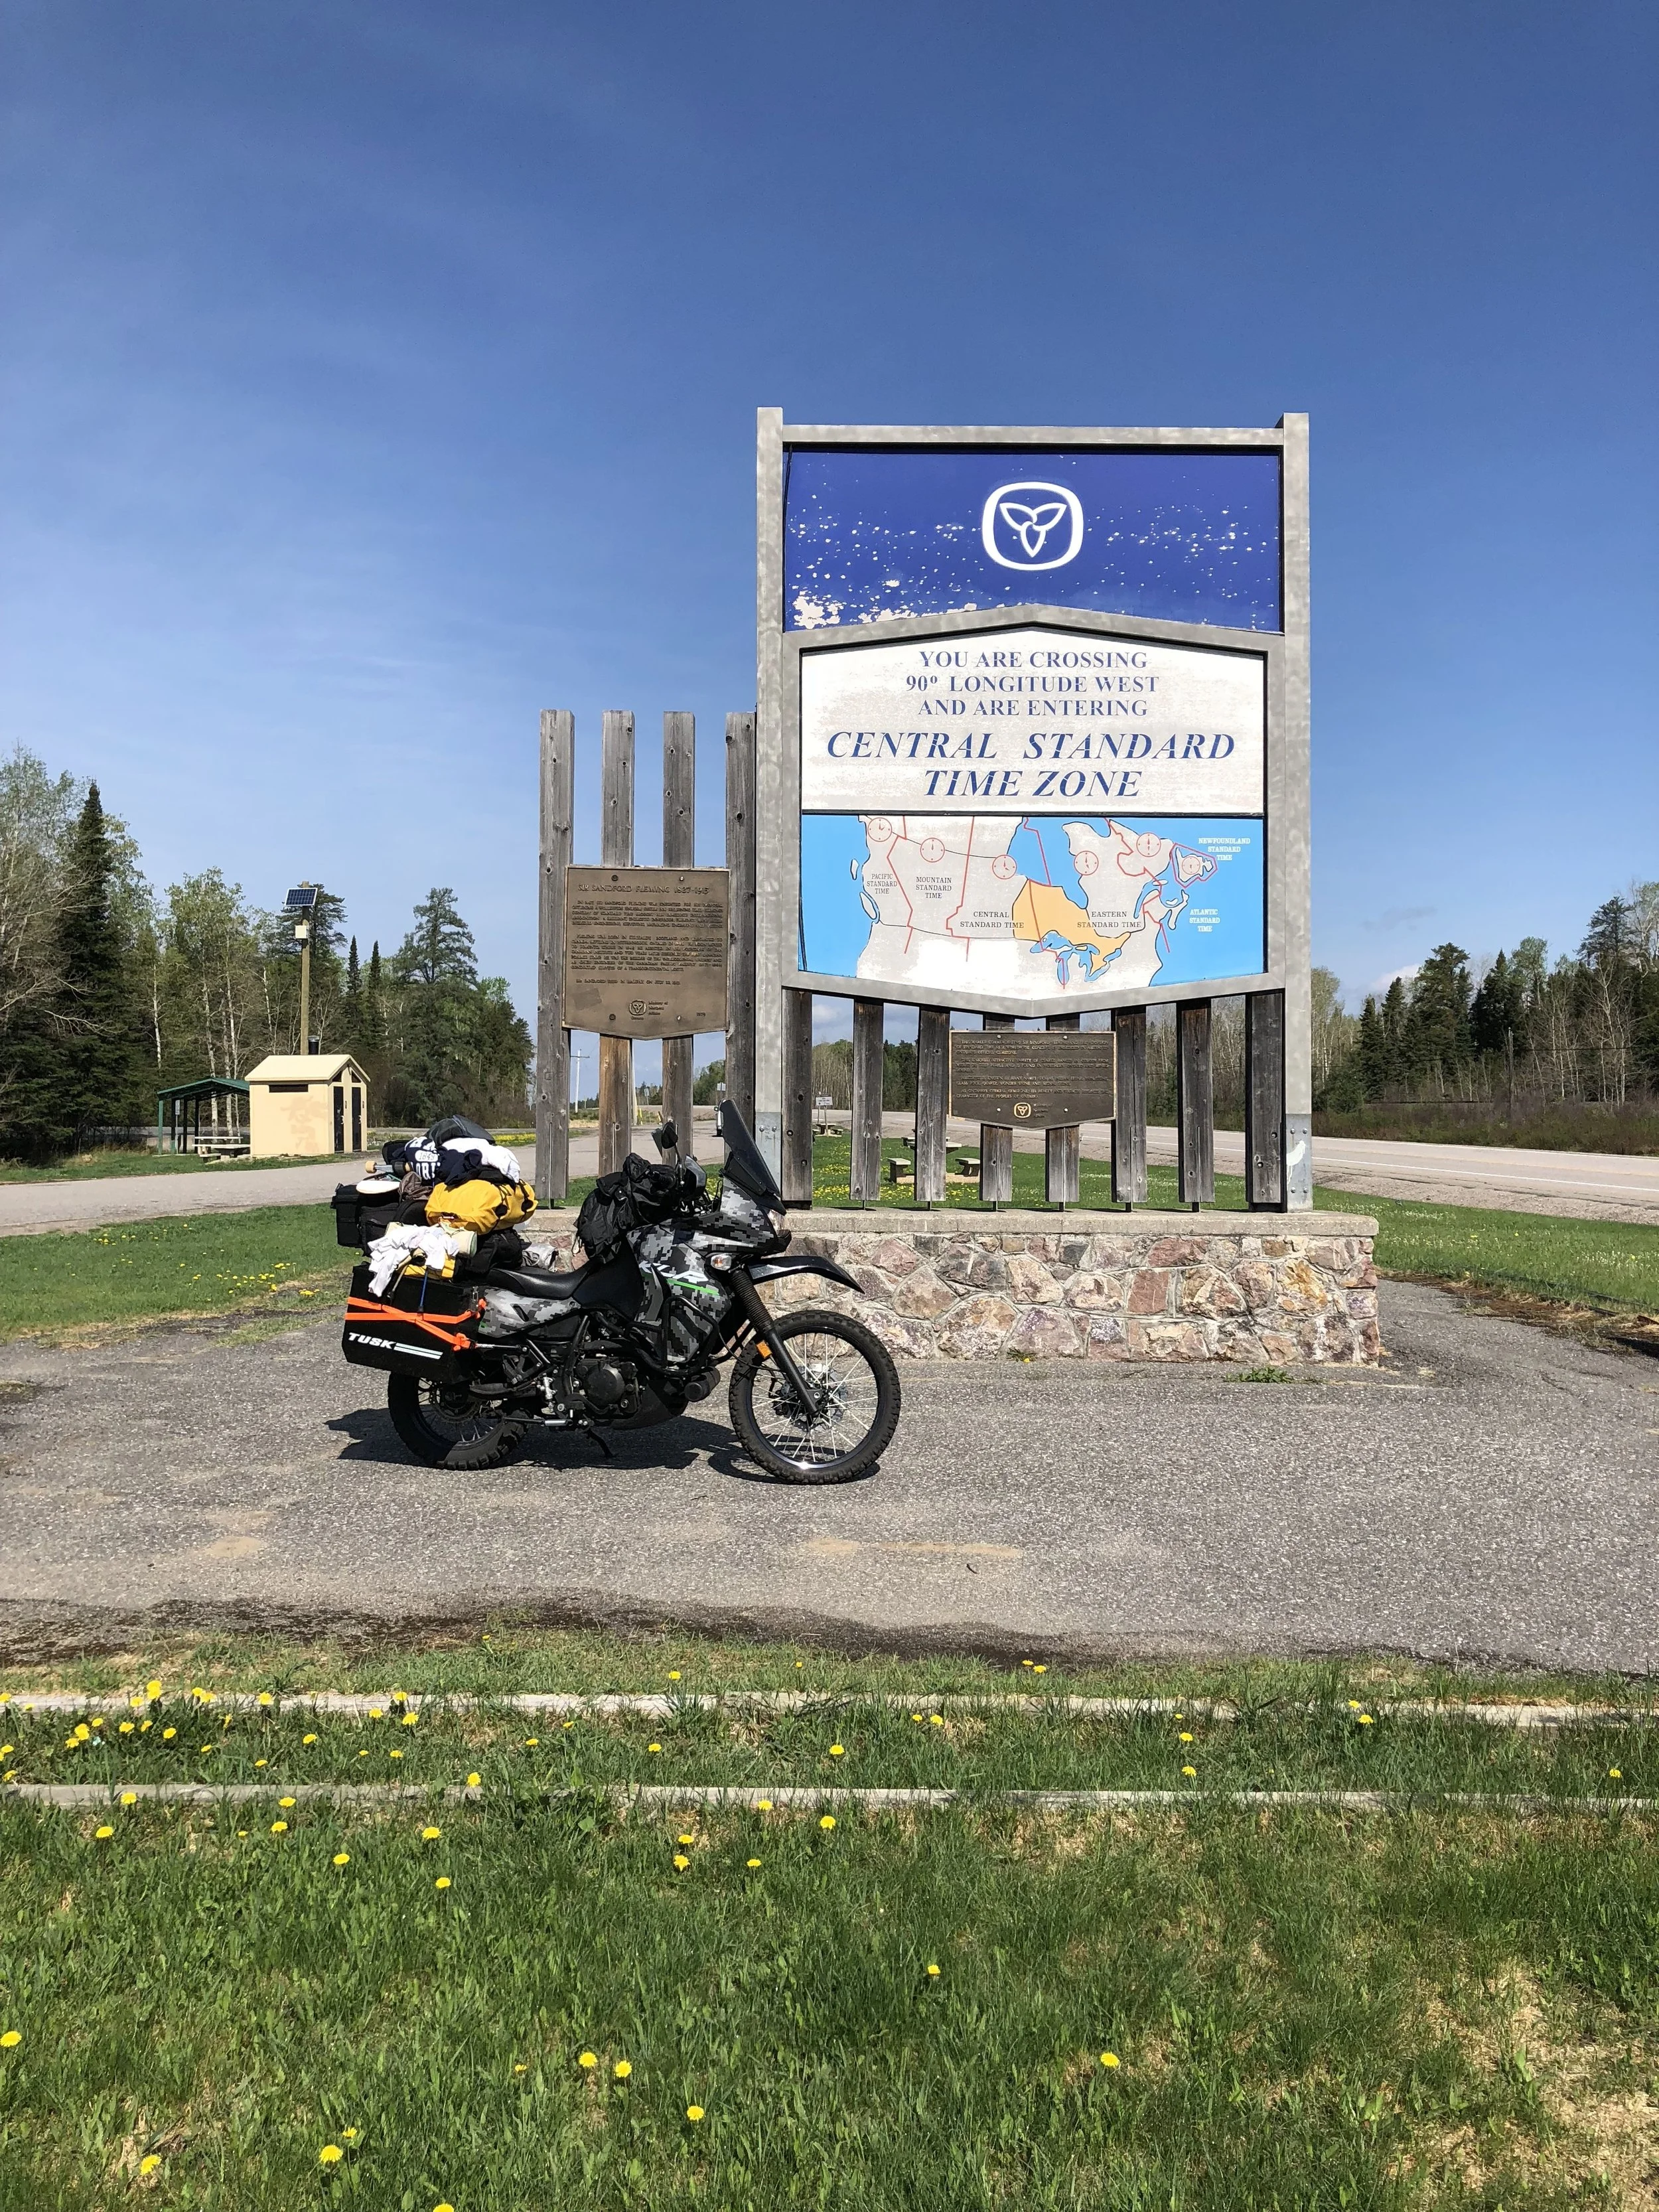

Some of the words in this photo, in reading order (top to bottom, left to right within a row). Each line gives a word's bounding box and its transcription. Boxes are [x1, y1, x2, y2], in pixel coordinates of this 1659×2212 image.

[919, 651, 968, 668] YOU
[975, 652, 1022, 668] ARE
[1030, 651, 1148, 669] CROSSING
[950, 676, 1088, 693] LONGITUDE
[1094, 676, 1160, 693] WEST
[918, 700, 966, 715] AND
[973, 700, 1020, 716] ARE
[1027, 700, 1148, 717] ENTERING
[827, 731, 998, 759] CENTRAL
[1023, 731, 1236, 760] STANDARD
[924, 770, 1023, 797] TIME
[1032, 770, 1143, 797] ZONE
[419, 1152, 435, 1161] 1849
[348, 1332, 396, 1350] TUSK
